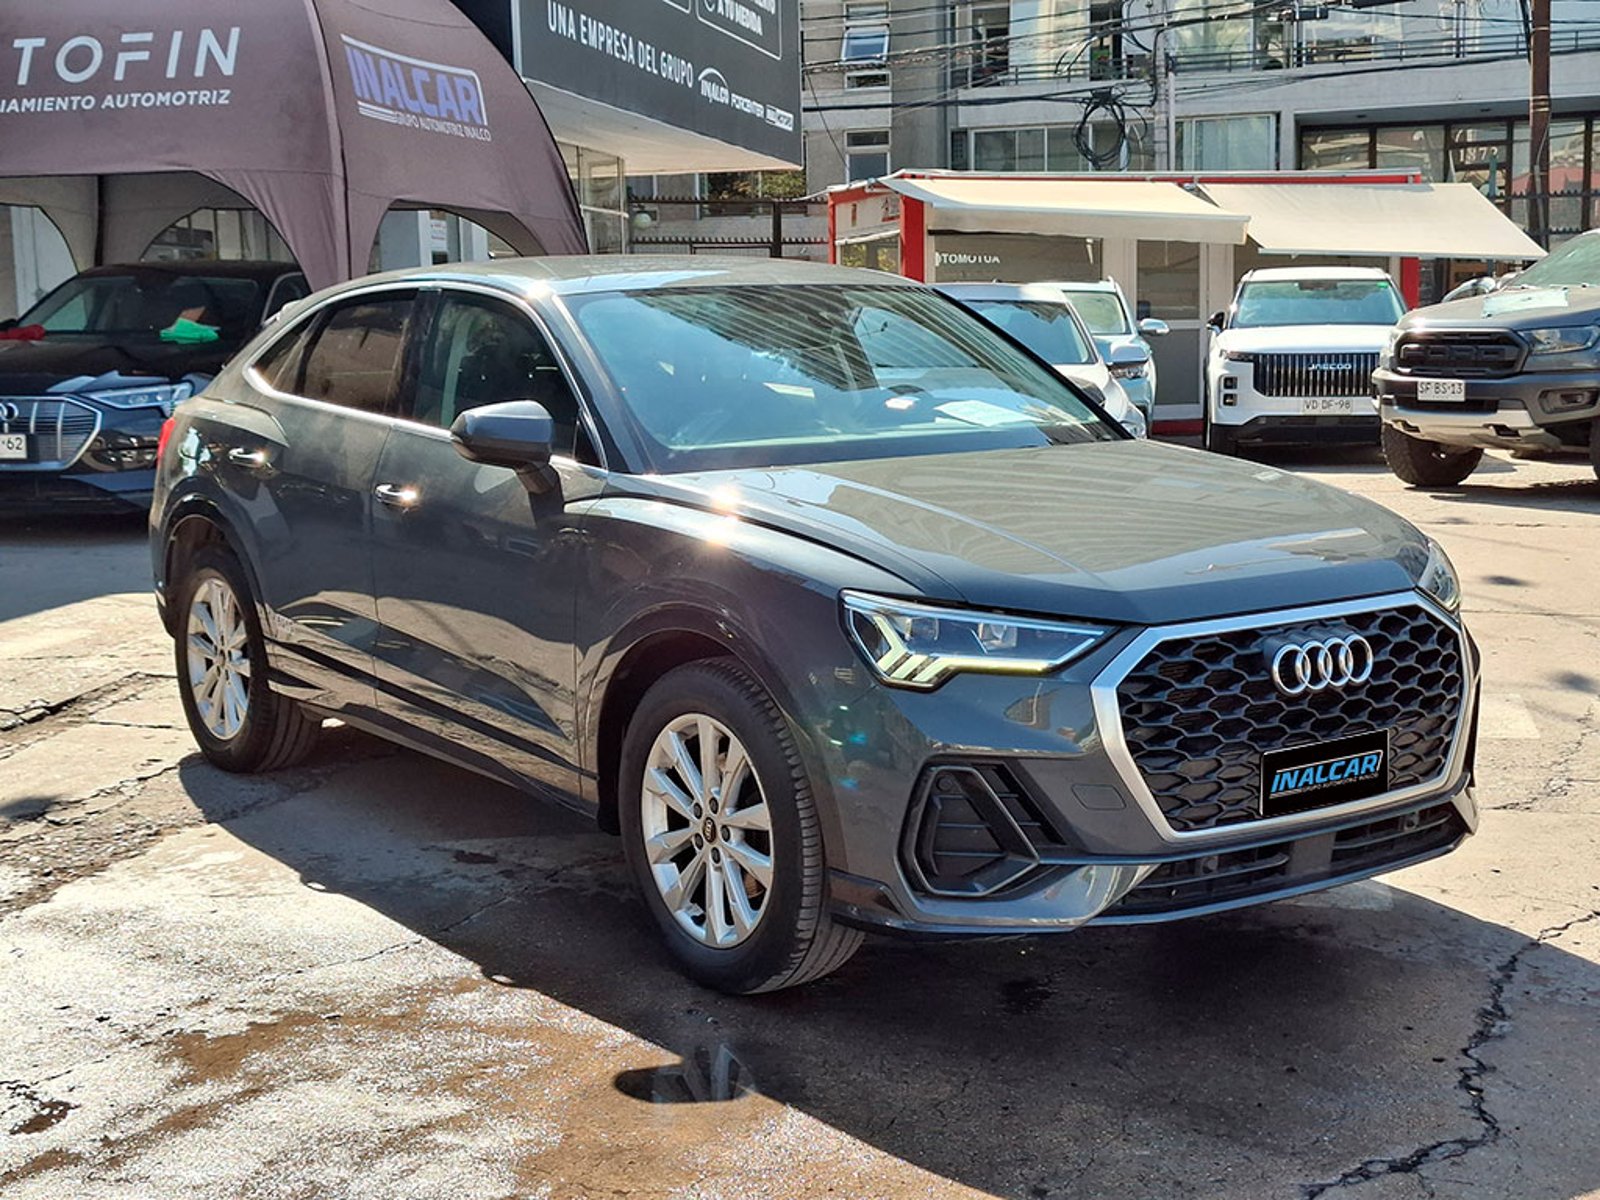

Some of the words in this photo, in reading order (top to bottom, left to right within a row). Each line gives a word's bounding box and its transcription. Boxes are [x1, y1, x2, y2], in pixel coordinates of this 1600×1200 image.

[13, 27, 241, 86] TOFIN
[547, 1, 577, 41] UNA
[580, 13, 636, 66] EMPRESA
[638, 39, 659, 75] DEL
[660, 51, 694, 89] GRUPO
[101, 89, 232, 110] AUTOMOTRIZ
[343, 44, 483, 126] INALCAR
[1419, 382, 1432, 394] SF
[1270, 754, 1379, 793] INALCAR
